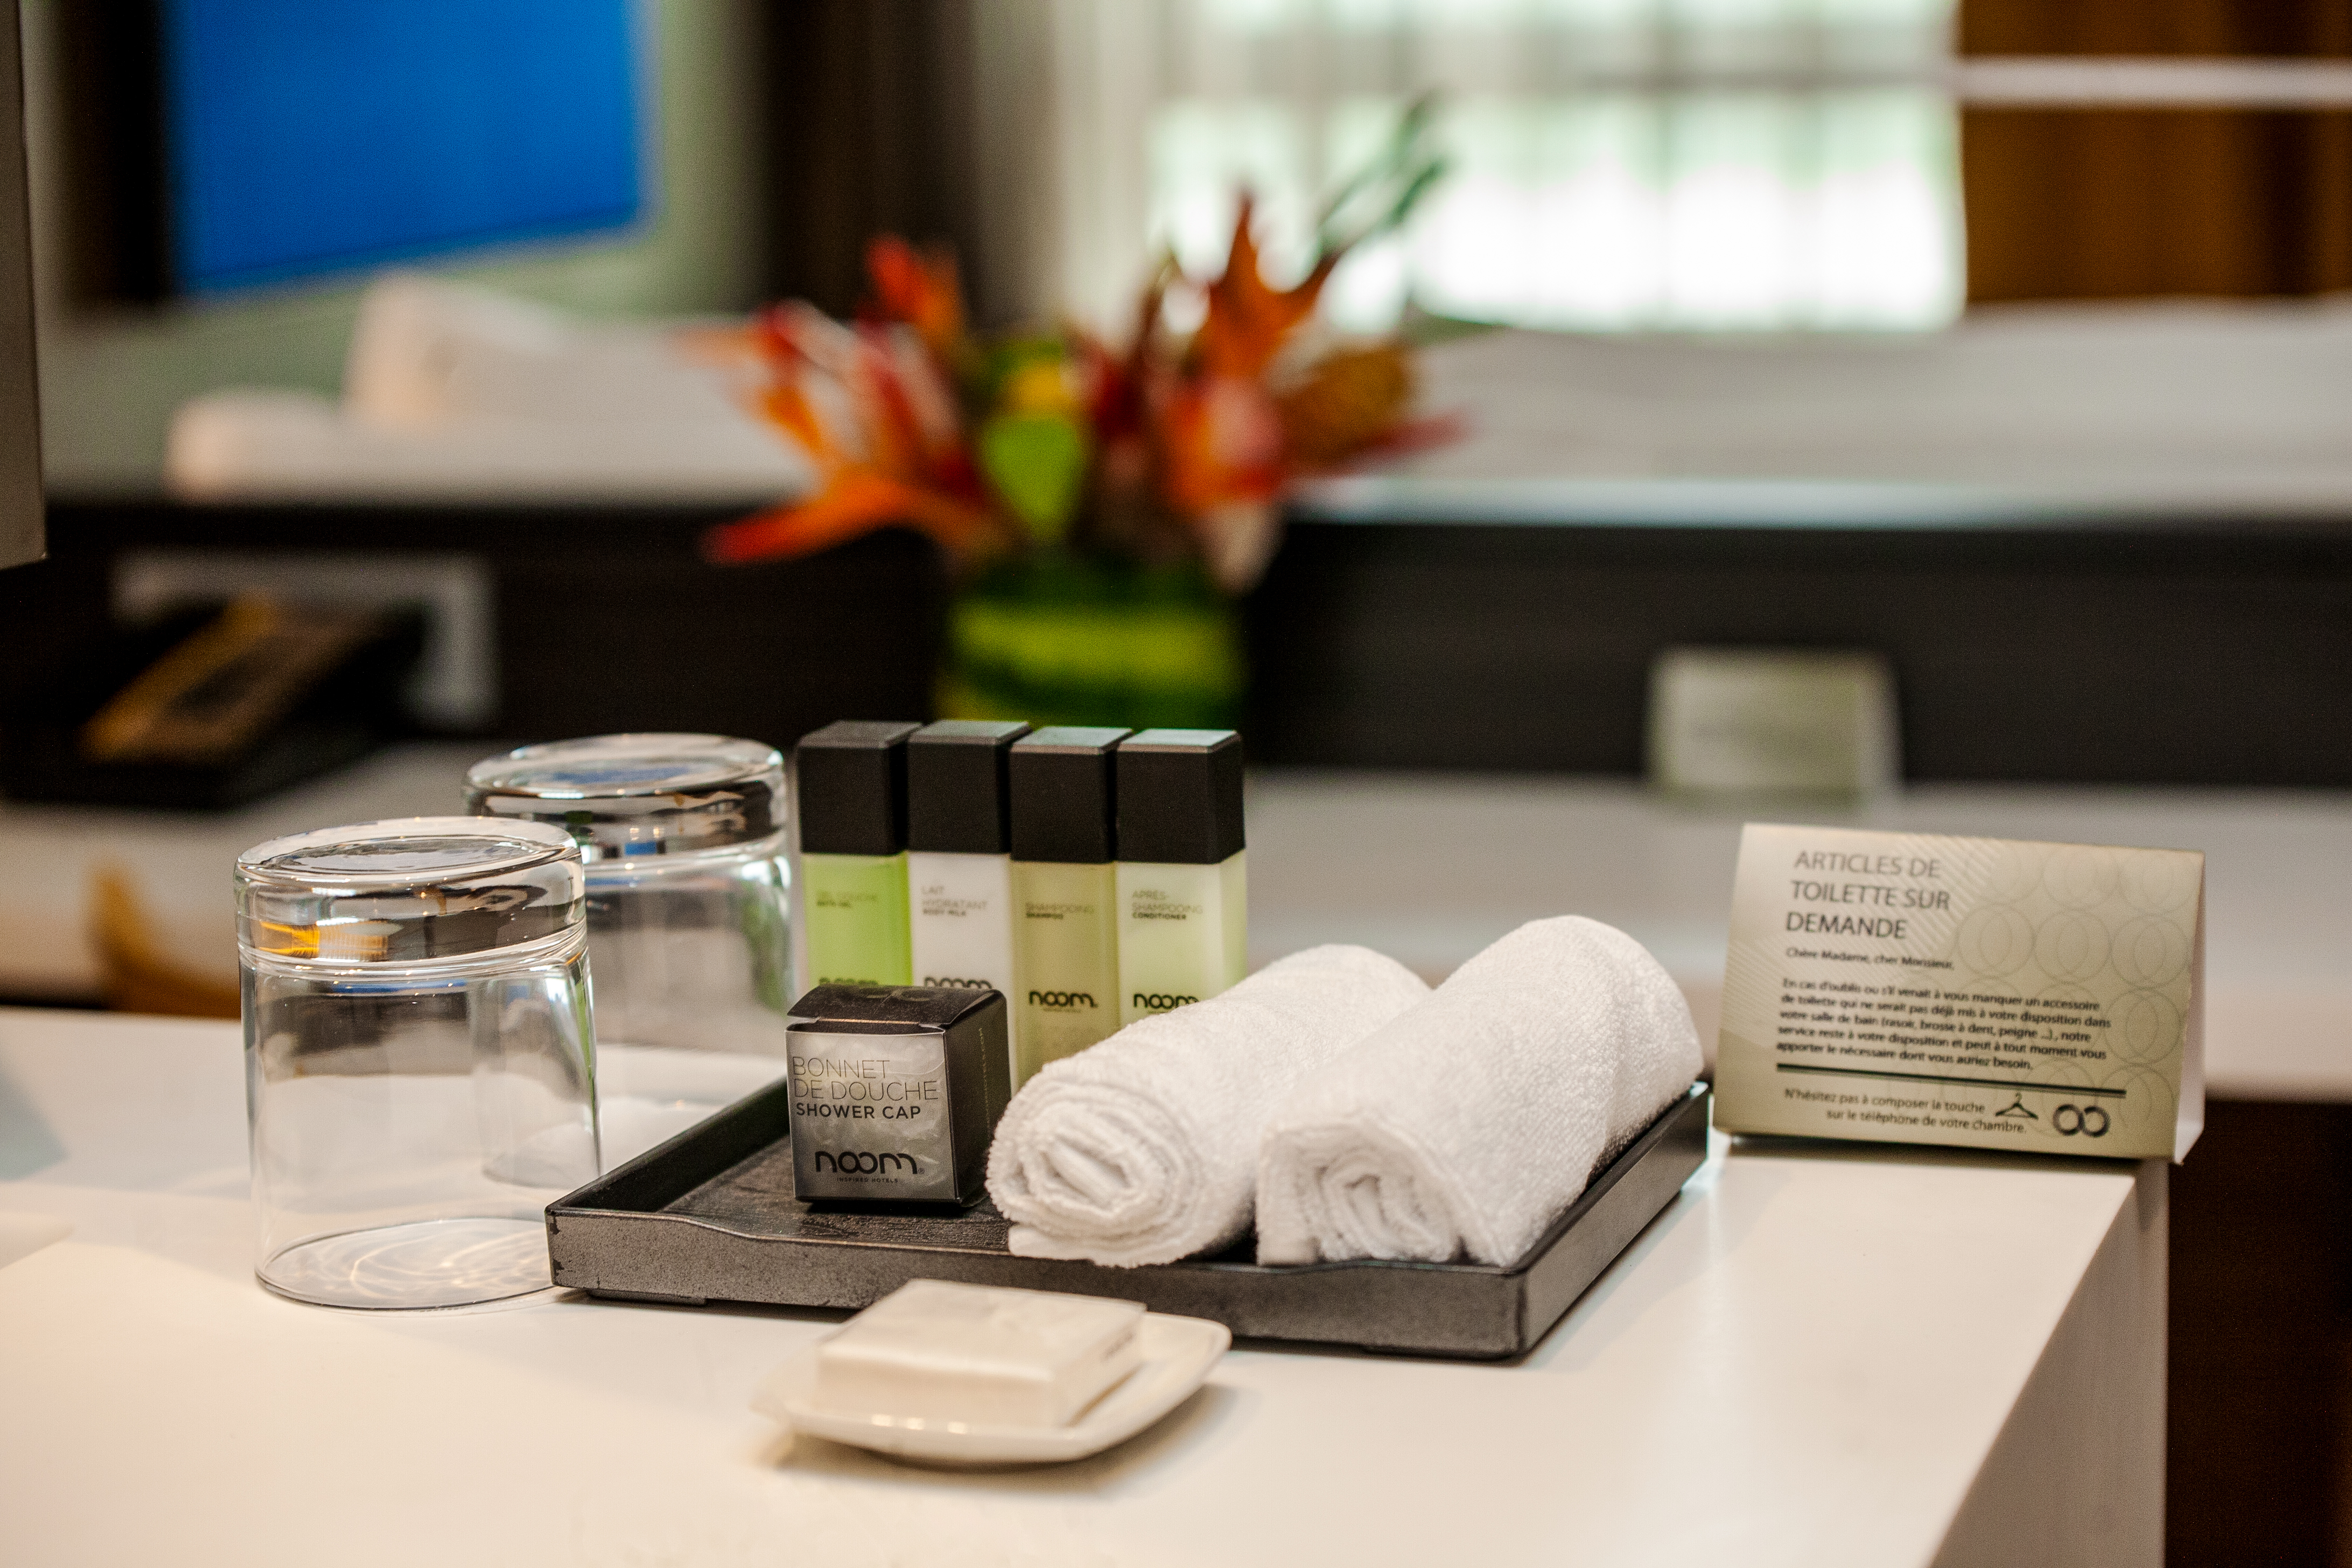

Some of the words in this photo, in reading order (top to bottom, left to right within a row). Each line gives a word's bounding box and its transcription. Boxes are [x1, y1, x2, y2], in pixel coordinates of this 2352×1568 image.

[1794, 850, 1902, 875] ARTICLES
[1909, 858, 1941, 878] DE
[922, 899, 988, 910] HYDRATANT
[1791, 880, 1896, 906] TOILETTE
[1903, 888, 1950, 911] SUR
[1132, 902, 1203, 914] SHAMPOOING
[1132, 912, 1187, 920] CONDITIONER
[1786, 912, 1908, 939] DEMANDE
[1786, 947, 1817, 958] Chère
[1822, 950, 1870, 964] Madame,
[1874, 954, 1898, 964] cher
[1783, 978, 1796, 988] En
[1799, 981, 1816, 989] cas
[1864, 986, 1879, 994] ou
[1899, 989, 1930, 998] venait
[1944, 992, 1969, 1001] vous
[1972, 994, 2021, 1006] manquer
[2025, 997, 2040, 1006] un
[2043, 999, 2100, 1011] accessoire
[1782, 993, 1794, 1003] de
[1798, 996, 1837, 1005] toilette
[1840, 1000, 1857, 1009] qui
[1878, 1003, 1906, 1011] serait
[1909, 1005, 1927, 1014] pas
[1931, 1005, 1955, 1017] déjà
[1957, 1007, 1976, 1017] mis
[1989, 1011, 2017, 1020] votre
[2021, 1011, 2082, 1025] disposition
[2085, 1016, 2111, 1028] dans
[1811, 1012, 1833, 1021] salle
[1838, 1014, 1850, 1023] de
[1854, 1014, 1878, 1024] bain
[1920, 1019, 1956, 1031] brosse
[1968, 1023, 1996, 1035] dent,
[1999, 1028, 2038, 1040] peigne
[2061, 1031, 2091, 1042] notre
[1777, 1042, 1823, 1053] apporter
[1826, 1044, 1836, 1053] le
[1840, 1045, 1895, 1057] nécessaire
[1899, 1051, 1925, 1060] dont
[1928, 1054, 1953, 1063] vous
[1957, 1055, 1990, 1066] auriez
[1778, 1027, 1815, 1035] service
[1818, 1030, 1845, 1038] reste
[1858, 1033, 1885, 1041] votre
[1888, 1033, 1949, 1048] disposition
[1951, 1040, 1963, 1048] et
[1965, 1040, 1991, 1051] peut
[2004, 1043, 2026, 1053] tout
[2030, 1046, 2077, 1057] moment
[2081, 1050, 2106, 1060] vous
[793, 1056, 890, 1079] BONNET
[794, 1079, 824, 1098] DE
[831, 1081, 939, 1101] DOUCHE
[1784, 1088, 1836, 1103] N'hésitez
[1840, 1093, 1858, 1104] pas
[1863, 1094, 1868, 1104] à
[1872, 1096, 1928, 1110] composer
[1932, 1099, 1942, 1110] la
[1944, 1101, 1985, 1113] touche
[796, 1103, 875, 1119] SHOWER
[882, 1106, 921, 1119] CAP
[1826, 1111, 1844, 1119] sur
[1847, 1109, 1857, 1119] le
[1860, 1111, 1918, 1125] téléphone
[1922, 1115, 1936, 1126] de
[1940, 1118, 1969, 1129] votre
[1972, 1119, 2026, 1133] chambre.
